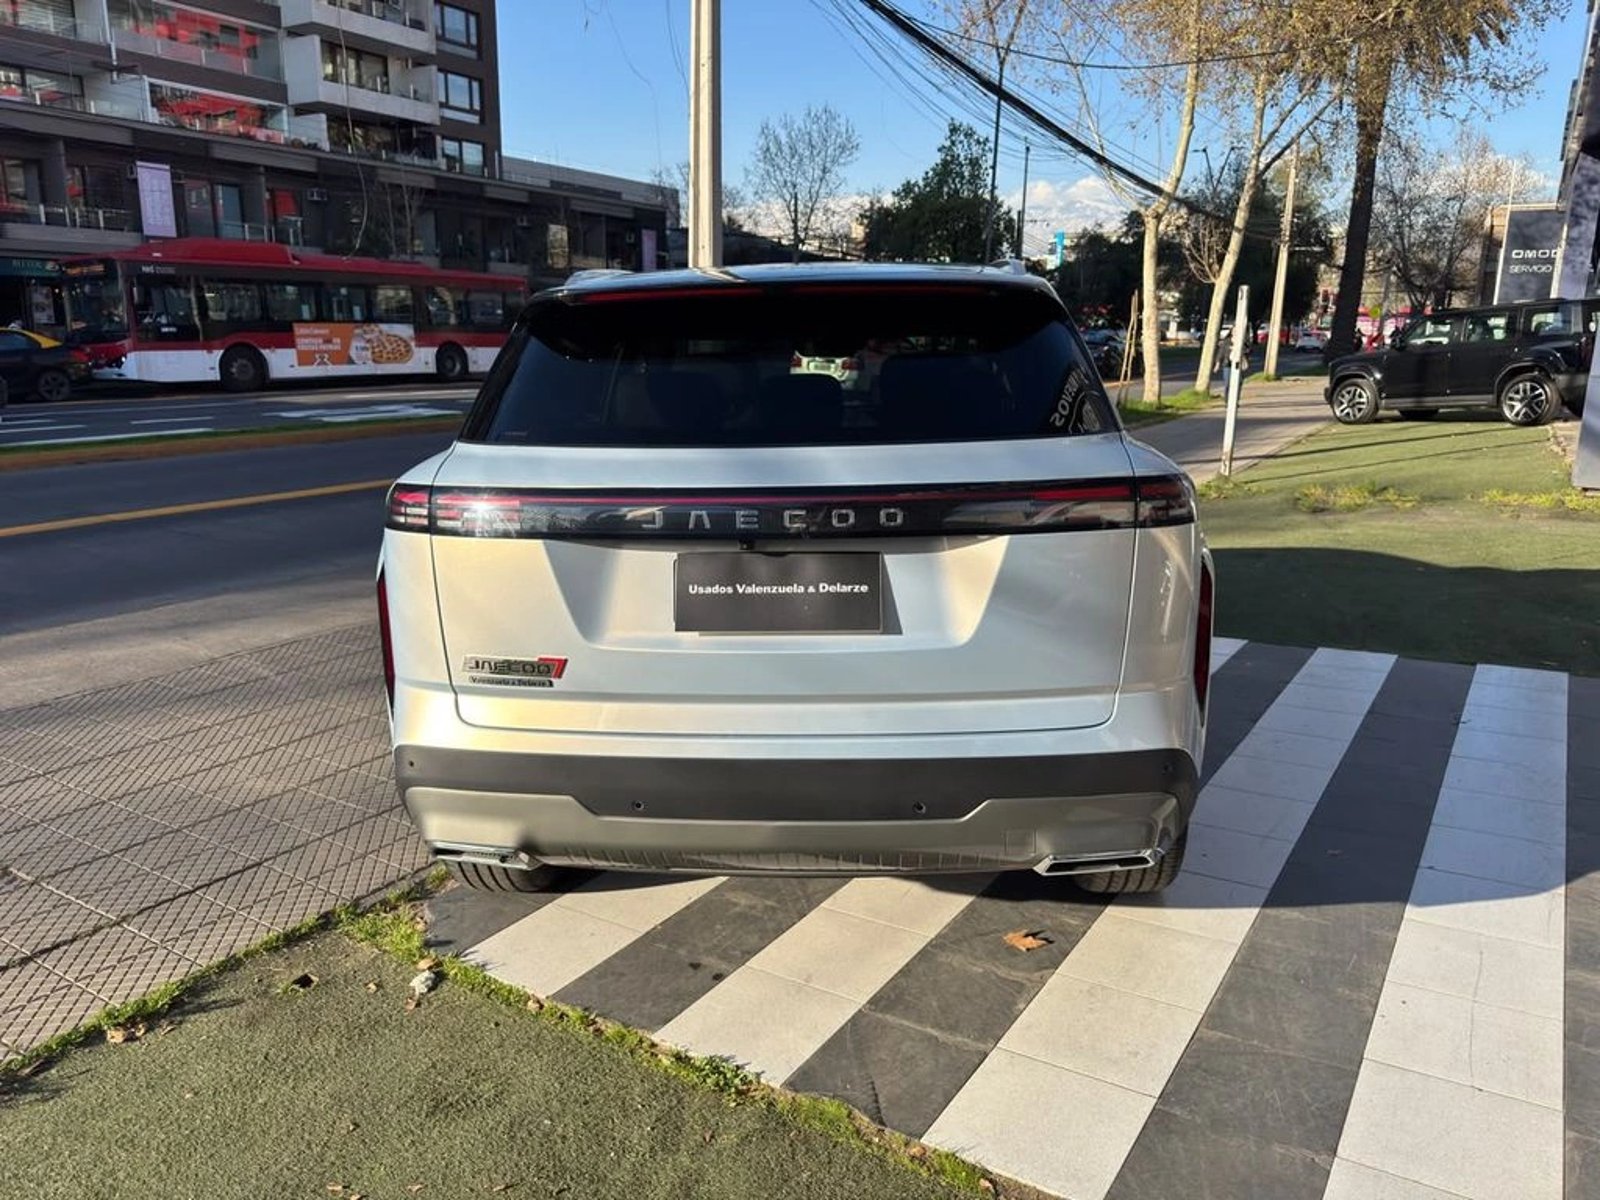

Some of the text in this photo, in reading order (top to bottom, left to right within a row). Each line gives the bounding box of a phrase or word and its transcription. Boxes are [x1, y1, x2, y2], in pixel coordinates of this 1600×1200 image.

[1512, 249, 1558, 259] OMOD
[1509, 264, 1553, 274] SERVICIO
[642, 508, 904, 530] JAECOO
[688, 582, 869, 594] Usados Valenzuela & Delarze
